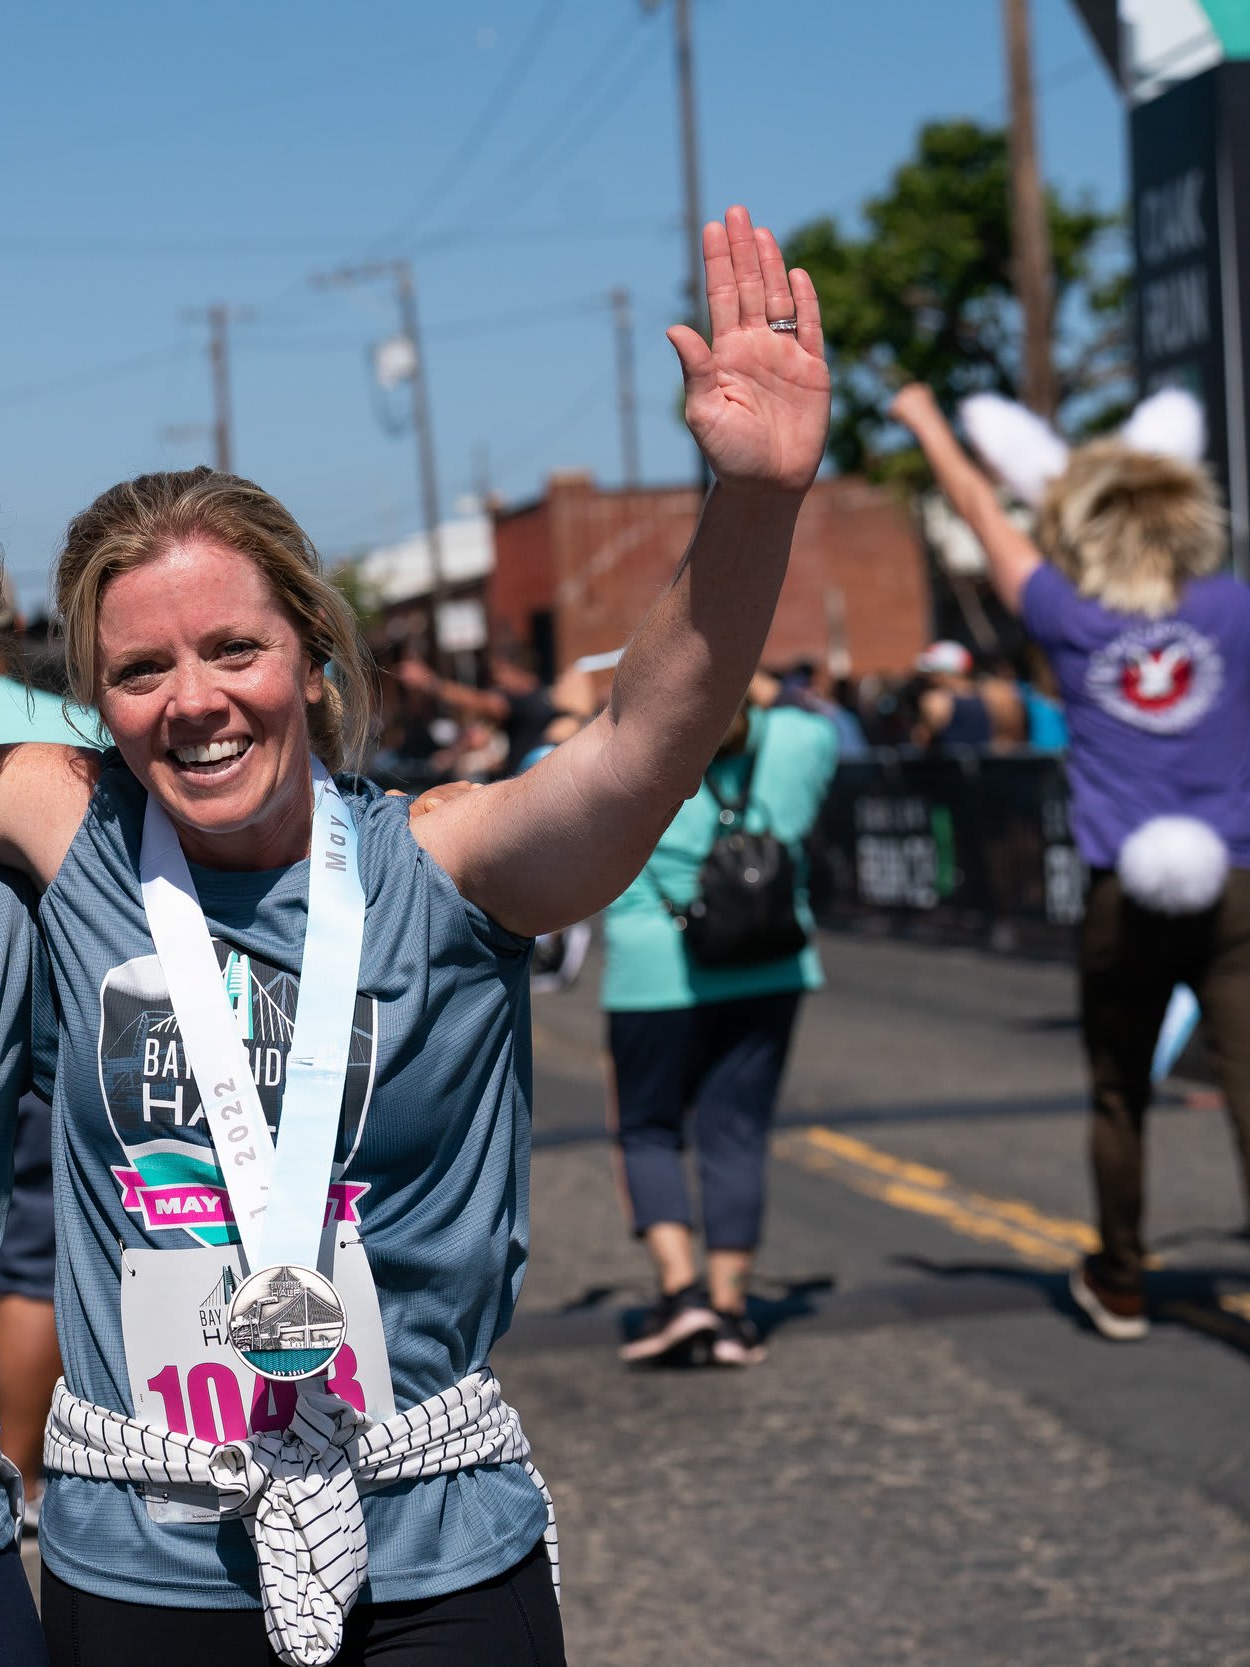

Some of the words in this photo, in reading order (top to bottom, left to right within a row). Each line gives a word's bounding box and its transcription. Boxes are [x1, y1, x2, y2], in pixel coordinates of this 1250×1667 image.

[324, 815, 350, 872] May
[213, 1077, 257, 1167] 2022
[154, 1195, 221, 1215] MAY
[199, 1308, 222, 1327] BAY
